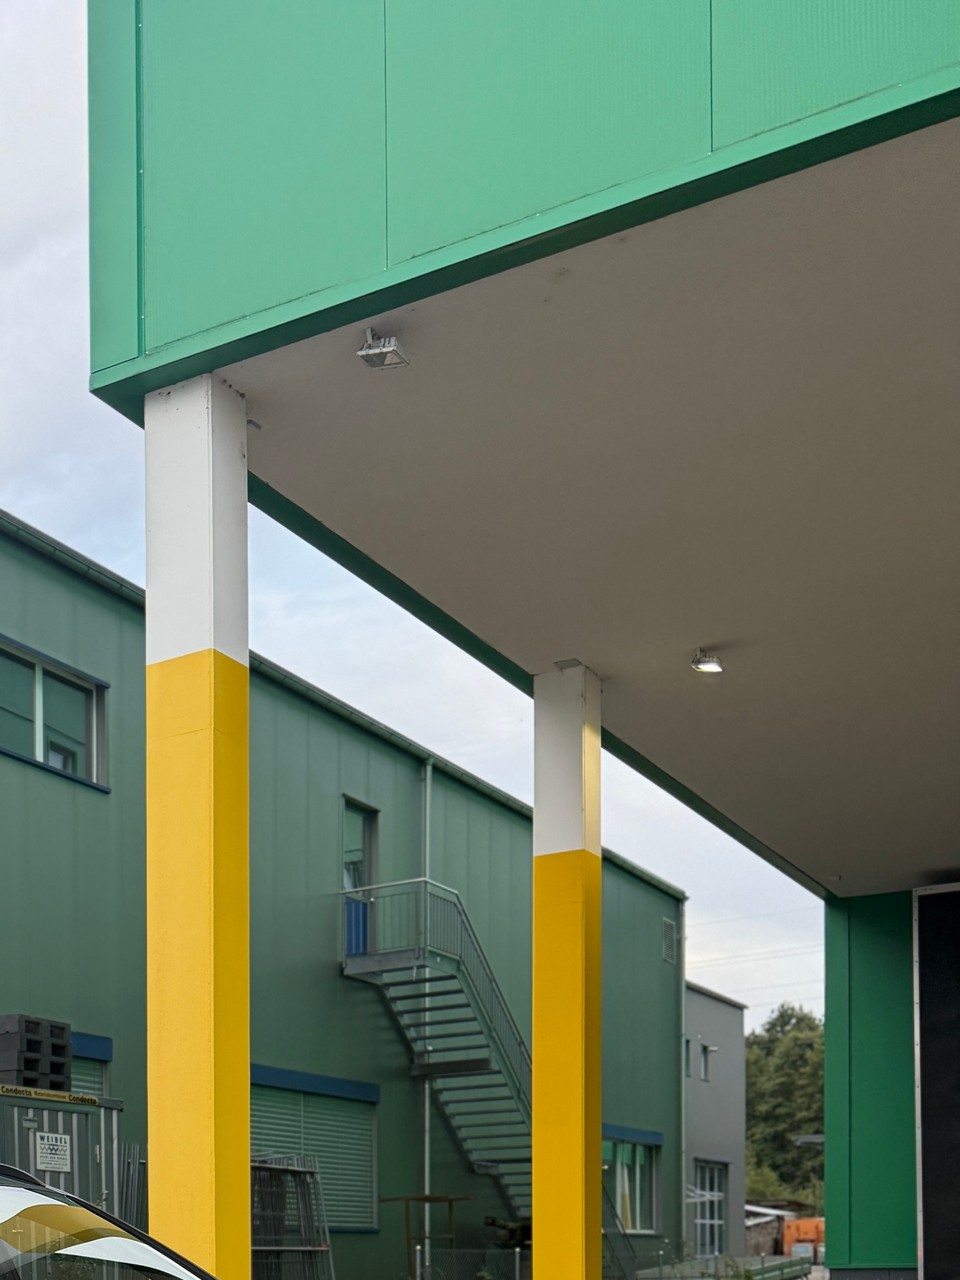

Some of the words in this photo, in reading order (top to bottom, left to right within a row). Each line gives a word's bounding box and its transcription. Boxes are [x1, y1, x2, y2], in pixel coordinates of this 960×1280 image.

[1, 1086, 32, 1096] Condecta
[68, 1094, 97, 1104] Condecta
[39, 1135, 67, 1145] WEIBEL
